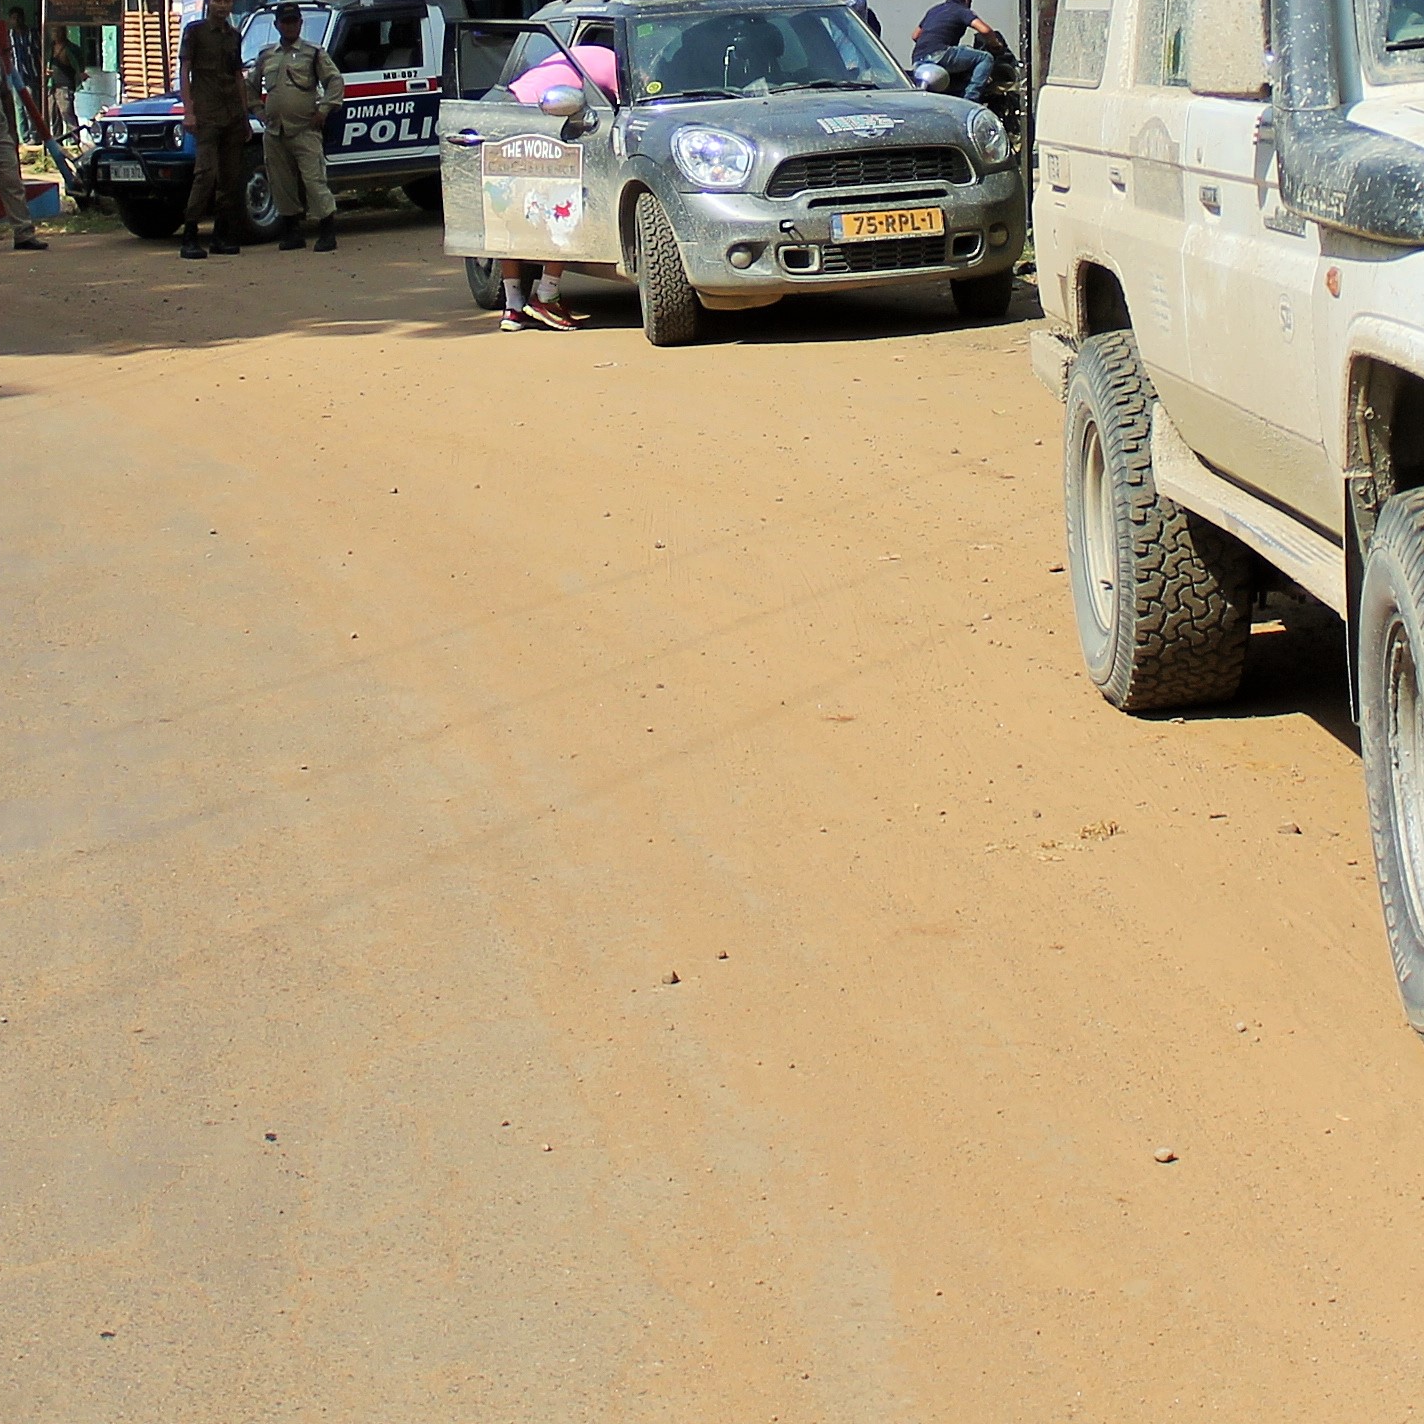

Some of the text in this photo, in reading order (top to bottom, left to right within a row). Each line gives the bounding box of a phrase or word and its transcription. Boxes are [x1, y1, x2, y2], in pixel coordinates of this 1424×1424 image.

[346, 101, 416, 120] DIMAPUR
[502, 139, 563, 160] THE WORLD
[853, 211, 935, 235] 75-RPL-1
